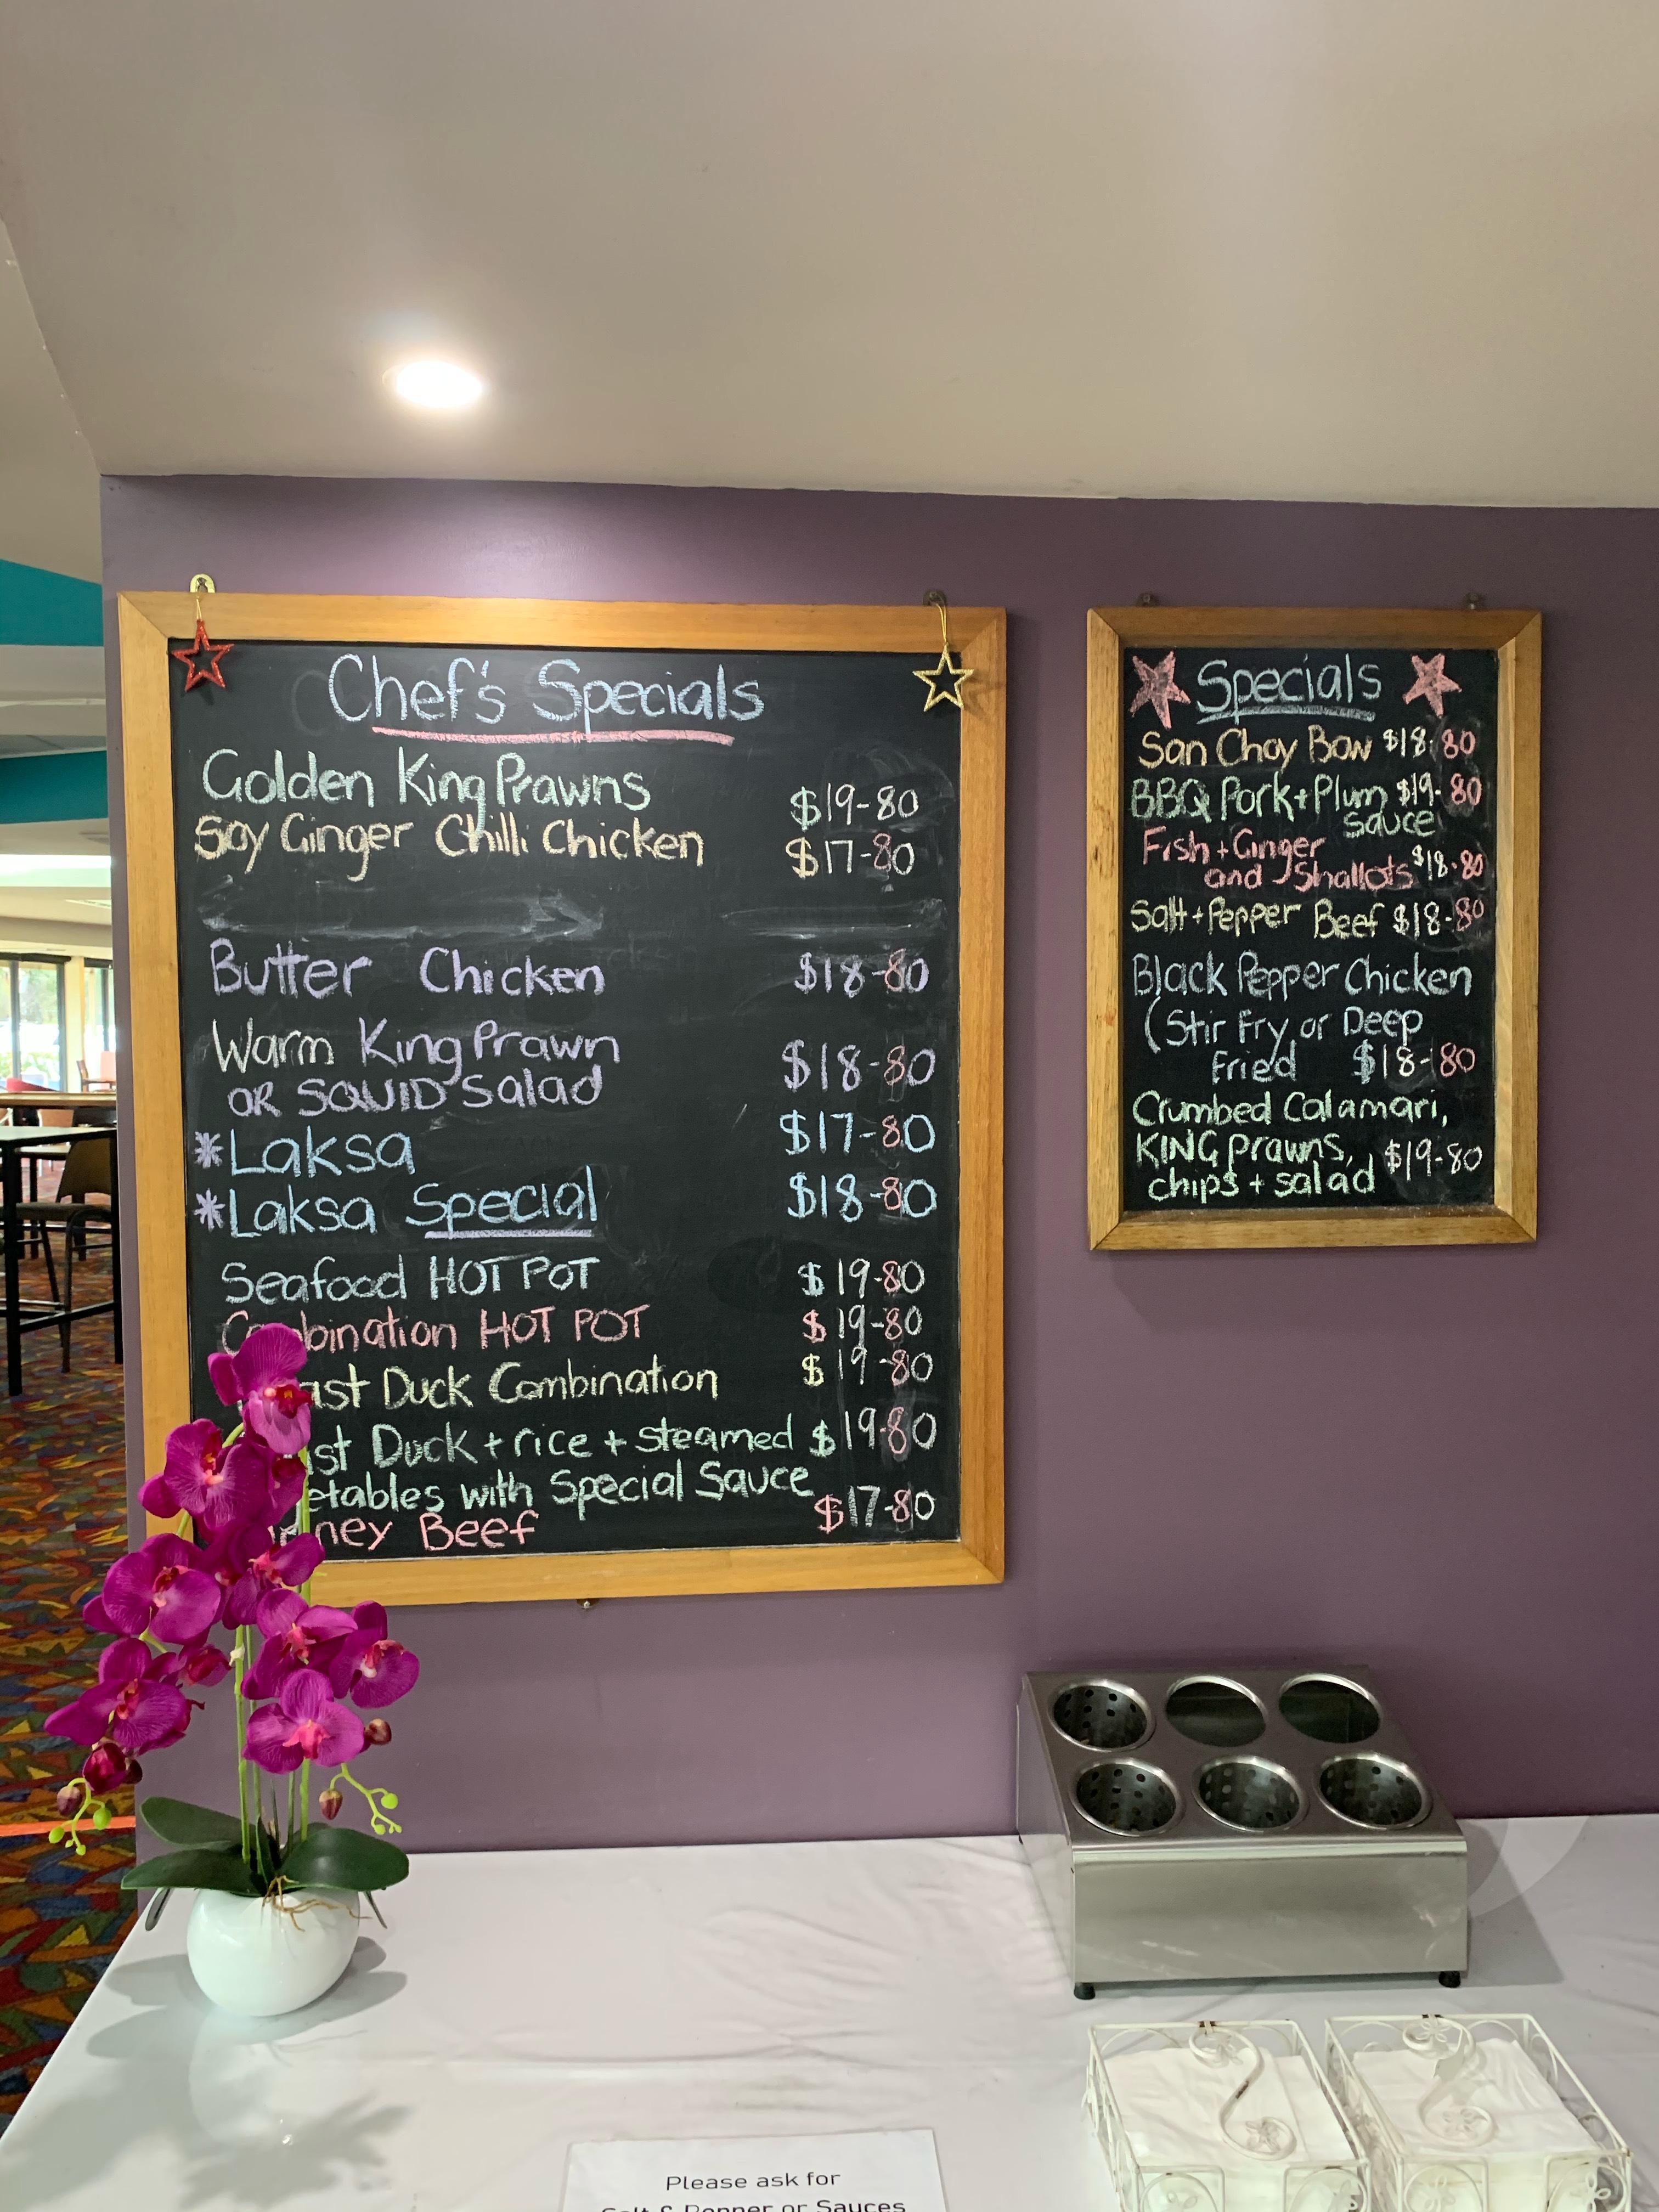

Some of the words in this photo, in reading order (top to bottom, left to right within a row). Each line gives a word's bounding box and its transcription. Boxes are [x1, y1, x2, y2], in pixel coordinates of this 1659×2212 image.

[329, 653, 506, 725] Chef's
[532, 659, 765, 735] Specials
[1197, 653, 1381, 723] Specials
[1139, 731, 1207, 768] San
[1216, 728, 1298, 774] Choy
[1308, 725, 1373, 763] Bow
[202, 748, 374, 808] Golden
[398, 746, 487, 838] King
[496, 752, 651, 810] Prawns
[1131, 777, 1212, 823] BBQ
[194, 814, 269, 873] Soy
[280, 812, 414, 882] Ginger
[435, 811, 527, 857] Chilli
[542, 817, 704, 867] Chicken
[1143, 825, 1210, 865] Fish
[1204, 864, 1262, 890] and
[1294, 855, 1415, 892] Shallots
[1314, 898, 1386, 939] Beef
[210, 938, 373, 997] Butter
[419, 947, 606, 996] Chicken
[1133, 951, 1228, 996] Black
[1238, 949, 1340, 1000] Pepper
[1344, 952, 1472, 996] Chicken
[1300, 1013, 1333, 1040] or
[1344, 1006, 1424, 1046] Deep
[212, 1017, 335, 1074] Warm
[358, 1017, 463, 1087] King
[473, 1020, 621, 1064] Prawn
[1211, 1040, 1297, 1085] Fried
[298, 1077, 448, 1118] SQUID
[1132, 1090, 1272, 1126] Crumbed
[1284, 1089, 1448, 1127] Calamari,
[1137, 1129, 1218, 1169] KING
[405, 1165, 597, 1238] Special
[1250, 1173, 1265, 1195] +
[221, 1255, 408, 1304] Seafood
[430, 1255, 519, 1300] HOT
[222, 1309, 457, 1353] Cbination
[481, 1306, 555, 1350] HOT
[384, 1365, 474, 1409] Duck
[373, 1421, 478, 1468] Duck
[483, 1432, 504, 1459] +
[514, 1424, 593, 1458] rice
[604, 1430, 628, 1457] +
[635, 1413, 793, 1452] steamed
[460, 1469, 533, 1509] with
[550, 1459, 684, 1521] Special
[419, 1509, 540, 1551] Beef
[666, 2176, 747, 2191] Please
[757, 2172, 799, 2187] ask
[806, 2171, 841, 2186] for
